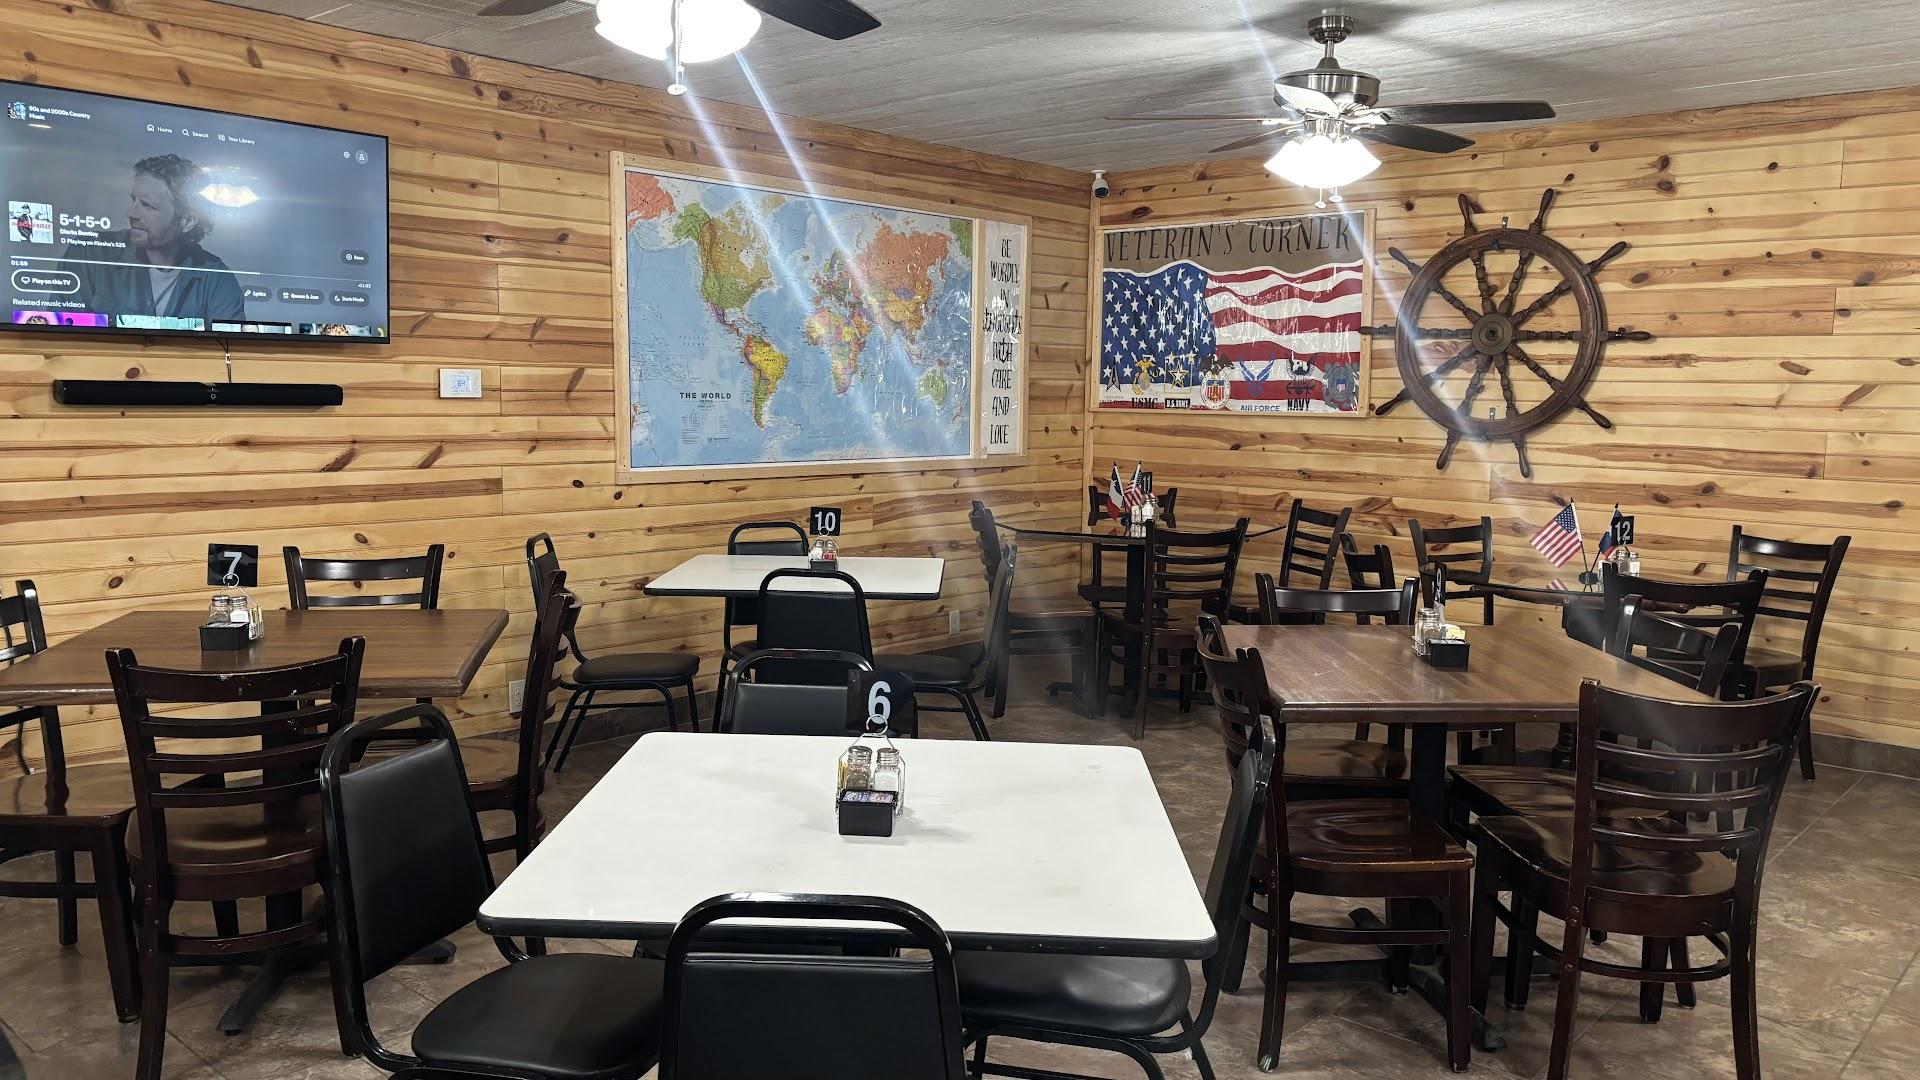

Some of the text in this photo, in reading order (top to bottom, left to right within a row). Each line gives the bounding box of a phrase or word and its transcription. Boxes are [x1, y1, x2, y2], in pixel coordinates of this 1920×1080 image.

[69, 110, 90, 120] Country
[238, 138, 255, 146] Library
[60, 214, 111, 230] 5-1-5-0
[1001, 238, 1012, 258] BE
[1106, 216, 1351, 263] VETERAN'S CORNER
[990, 260, 1020, 284] WORDLY
[992, 368, 1012, 390] CARE
[701, 392, 732, 400] WORLD
[992, 396, 1010, 416] AND
[1132, 397, 1158, 409] USMC
[1287, 398, 1310, 411] NAVY
[990, 424, 1010, 444] LOVE
[814, 511, 836, 532] 10
[1615, 520, 1630, 542] 12
[224, 551, 242, 580] 7
[868, 681, 892, 725] 6
